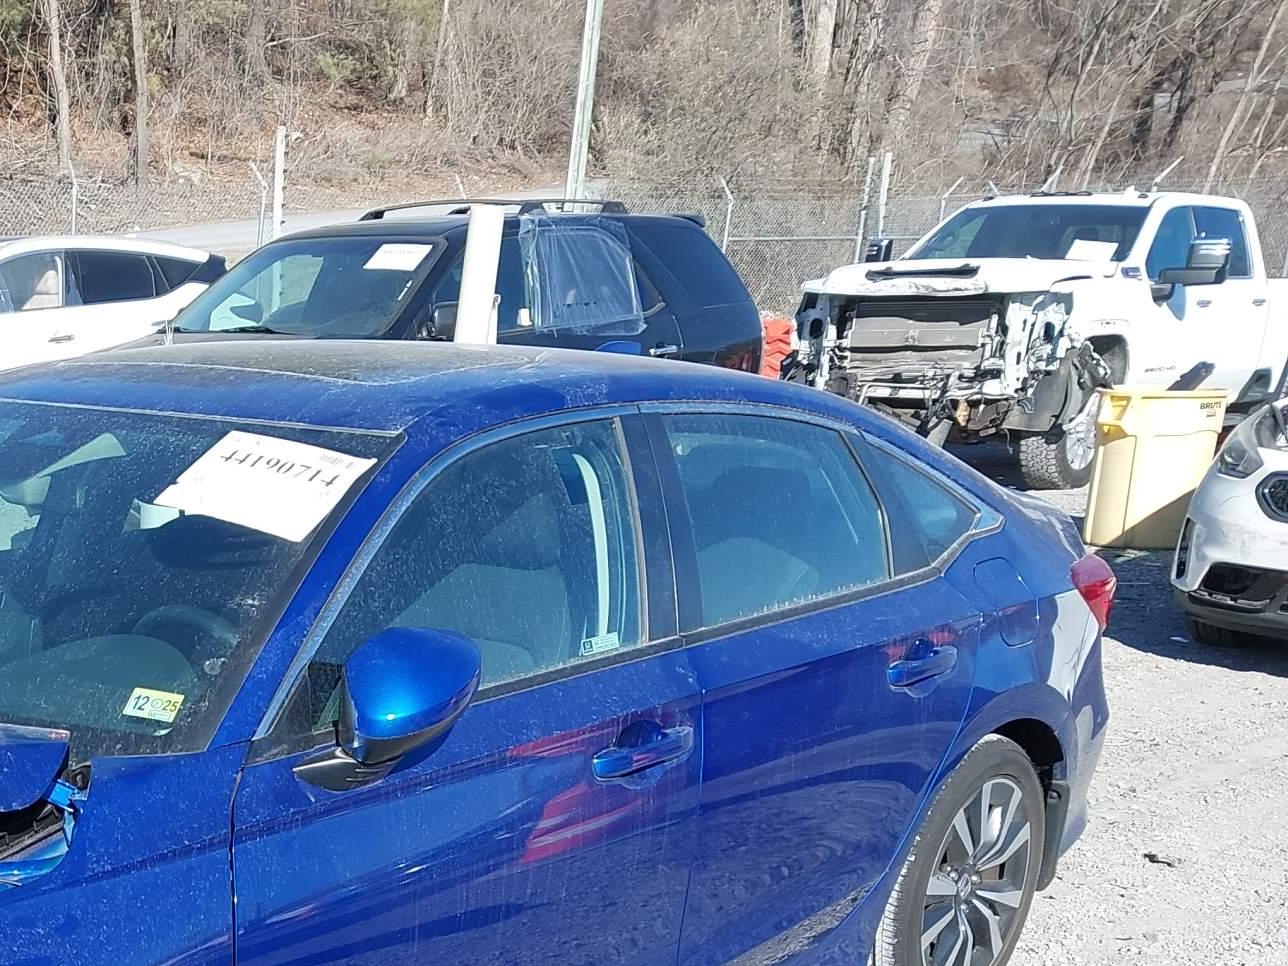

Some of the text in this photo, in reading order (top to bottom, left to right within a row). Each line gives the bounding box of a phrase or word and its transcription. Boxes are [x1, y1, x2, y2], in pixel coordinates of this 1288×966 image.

[219, 449, 341, 488] 44190714
[132, 694, 179, 713] 12 25
